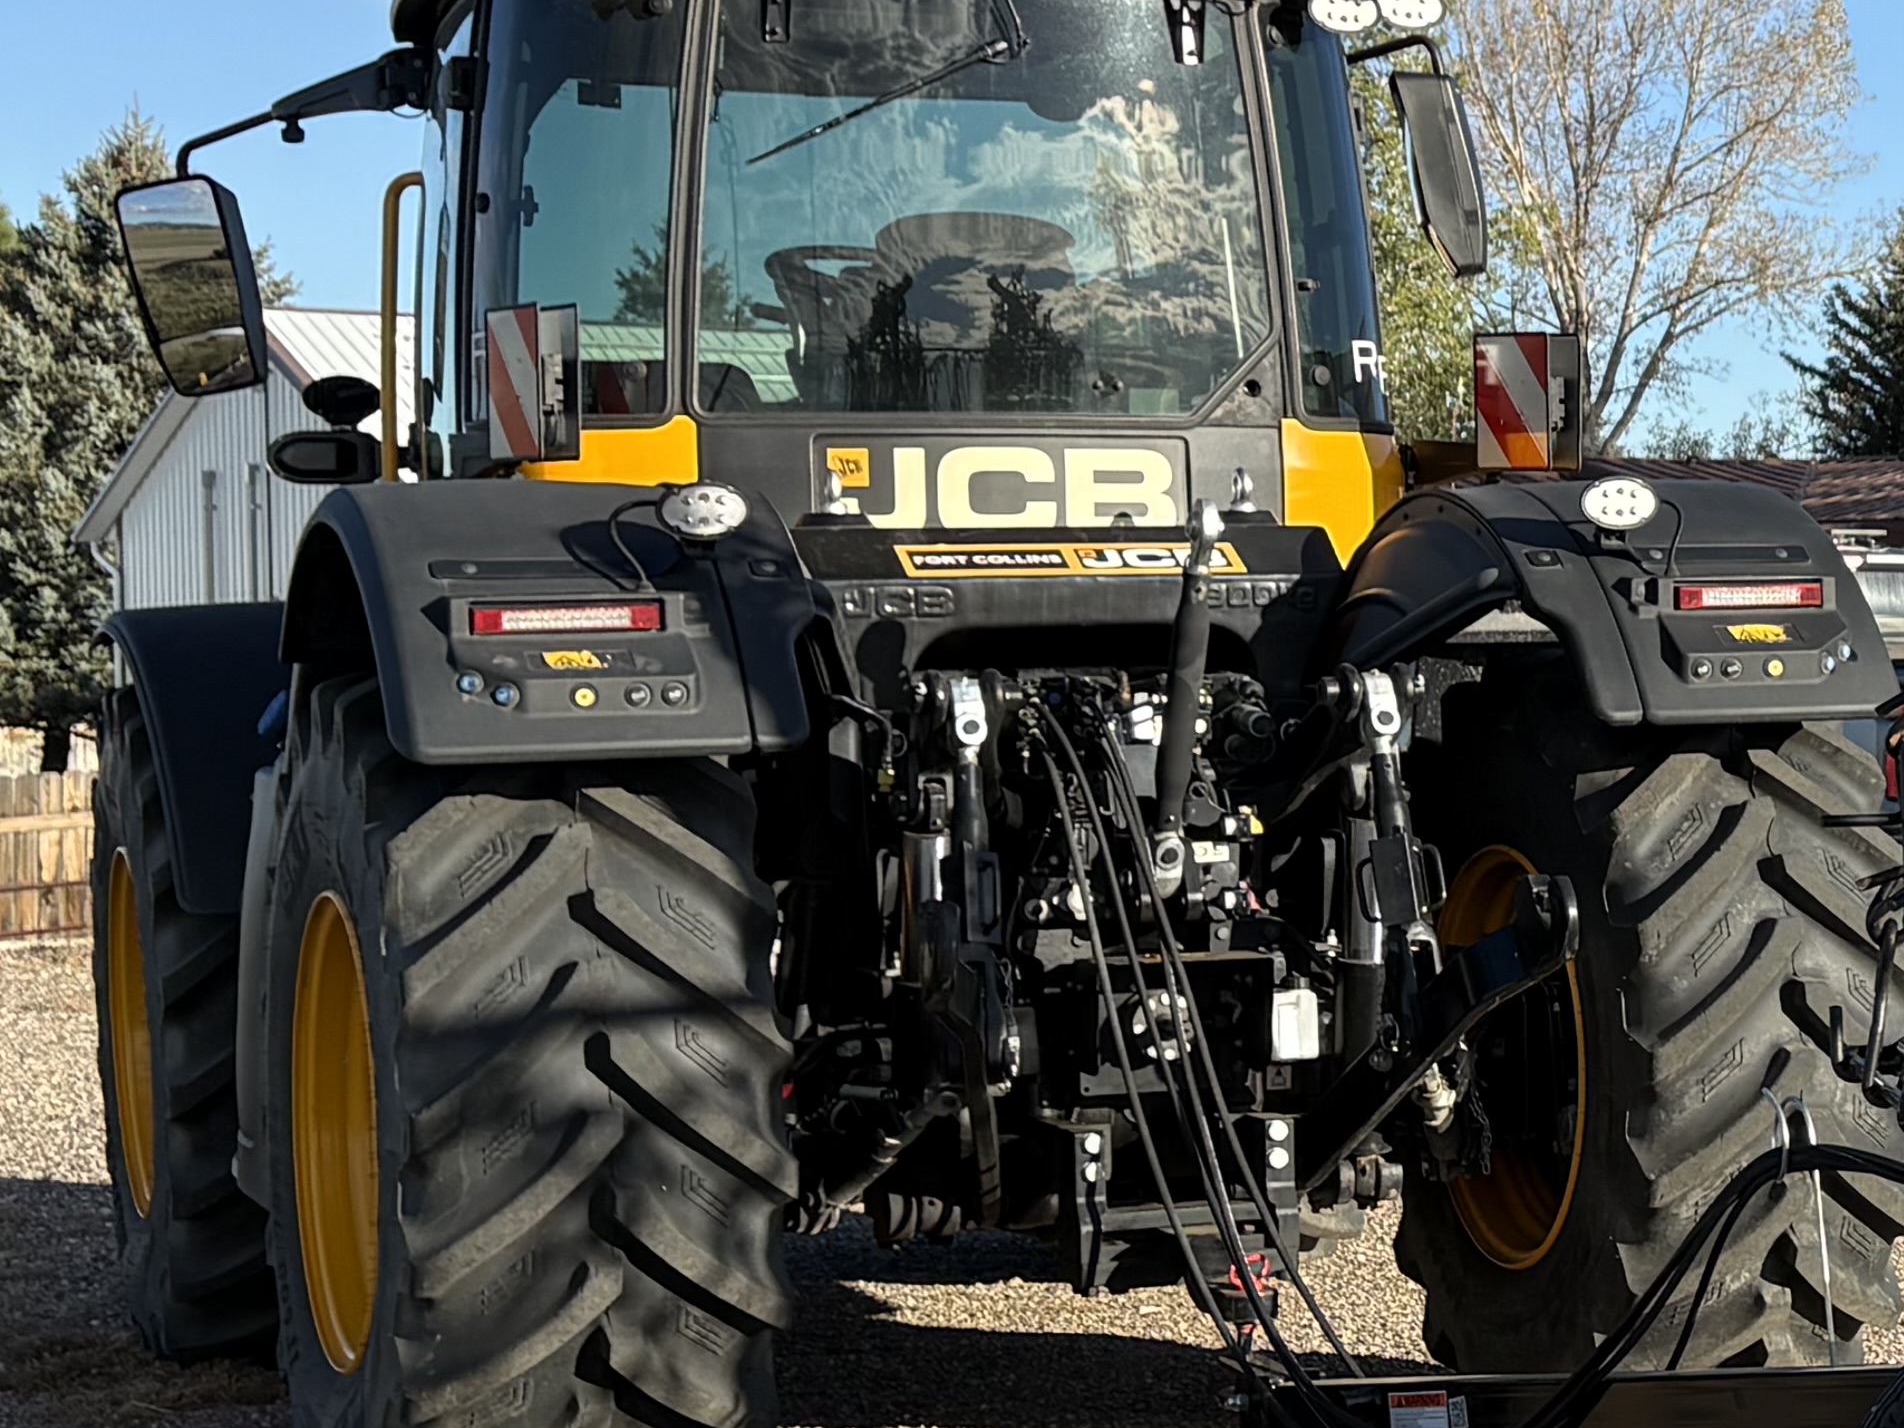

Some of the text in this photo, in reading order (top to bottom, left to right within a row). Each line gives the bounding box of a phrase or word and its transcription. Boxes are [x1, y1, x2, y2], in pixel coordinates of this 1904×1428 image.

[830, 446, 1178, 529] JCB
[913, 553, 1063, 566] FORT COLLINS
[842, 585, 955, 618] JCB
